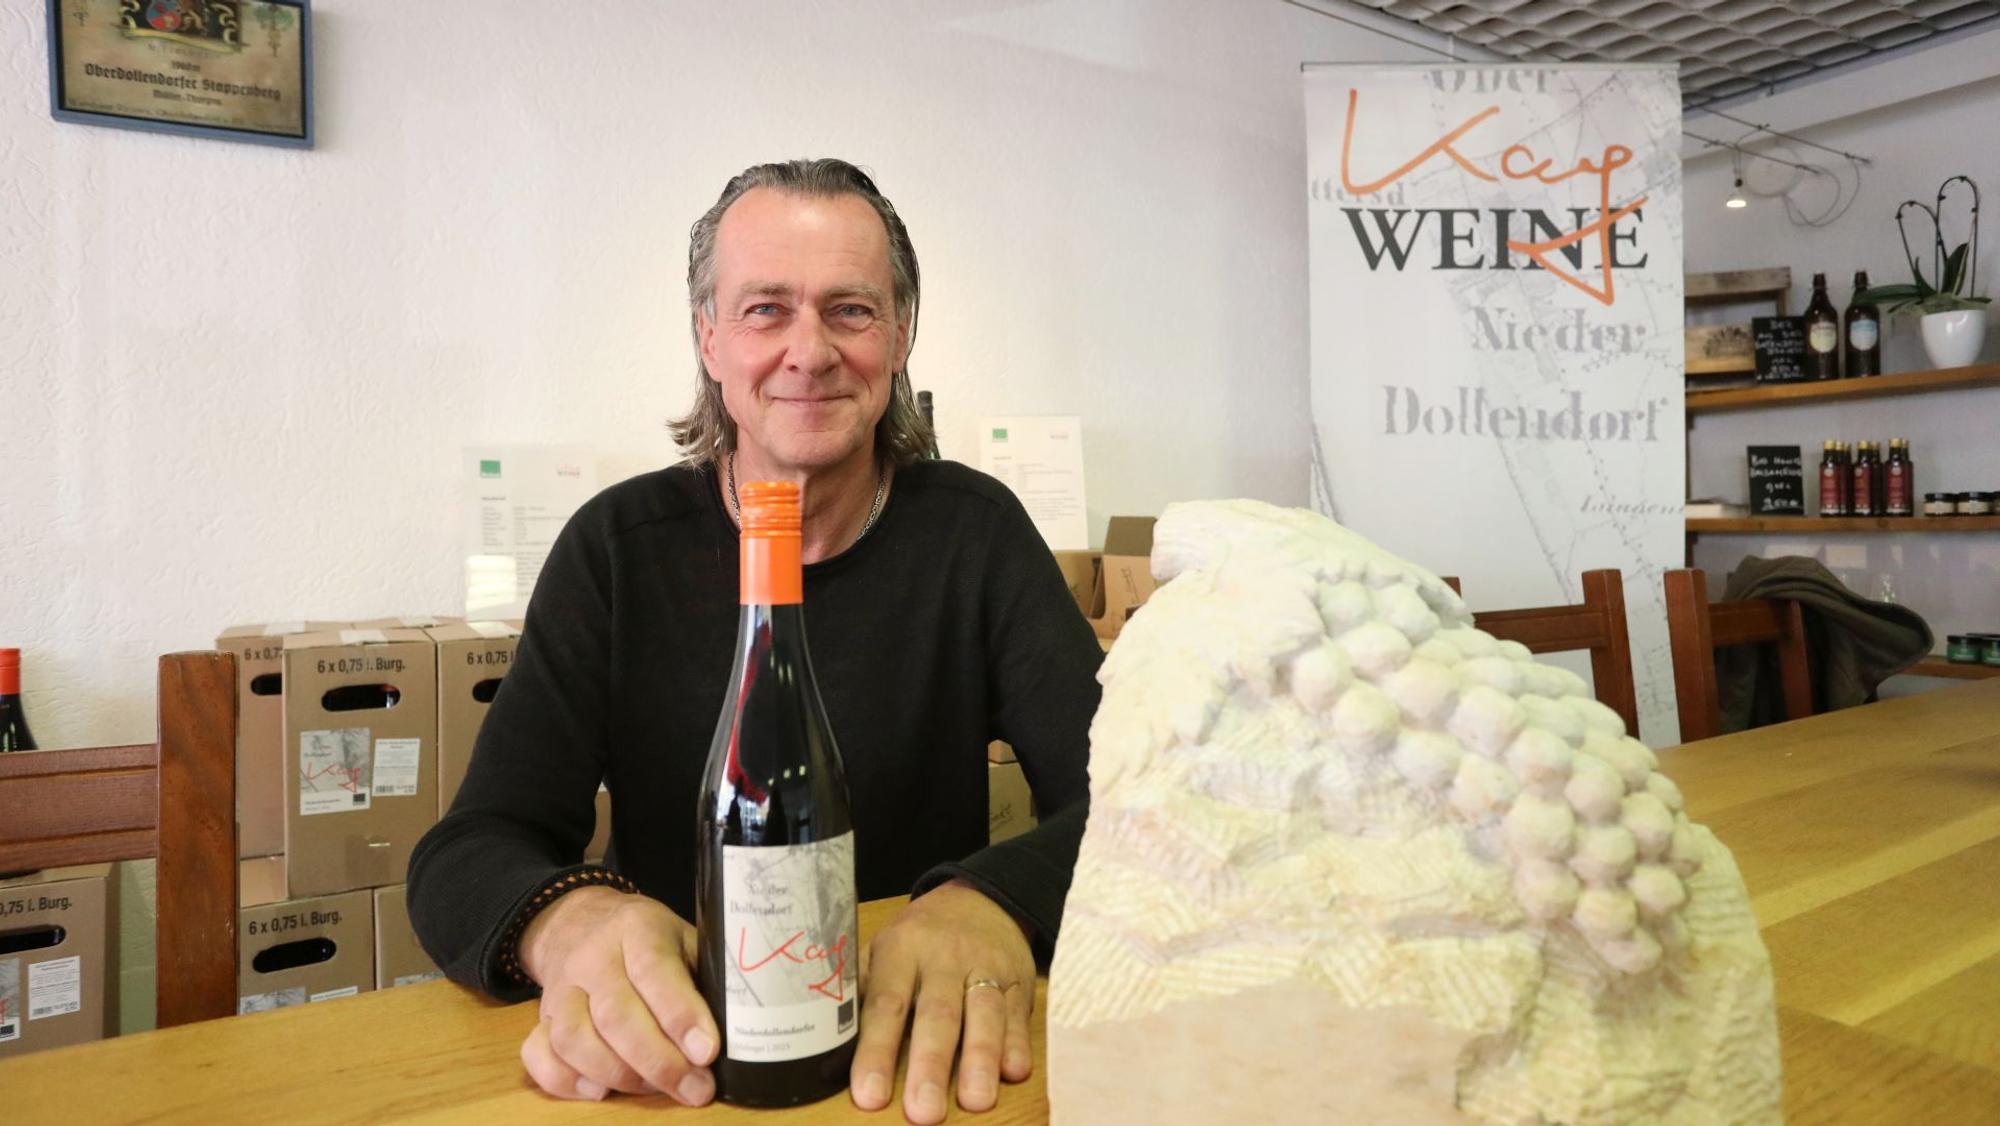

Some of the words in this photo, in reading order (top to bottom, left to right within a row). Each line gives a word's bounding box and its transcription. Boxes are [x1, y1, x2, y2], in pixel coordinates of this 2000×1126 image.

[1340, 208, 1649, 271] WEINE
[1471, 307, 1647, 353] Nieder
[1382, 385, 1669, 442] Dollendorf
[244, 648, 252, 661] 6
[254, 650, 261, 660] x
[467, 652, 474, 665] 6
[477, 655, 483, 665] x
[485, 651, 508, 666] 0,75
[317, 659, 326, 673] 6
[328, 662, 335, 673] x
[338, 658, 363, 674] 0,75
[376, 657, 406, 673] Burg.
[39, 896, 72, 911] Burg.
[249, 921, 257, 935] 6
[261, 921, 268, 934] x
[271, 915, 297, 933] 0,75
[311, 911, 343, 925] Burg.
